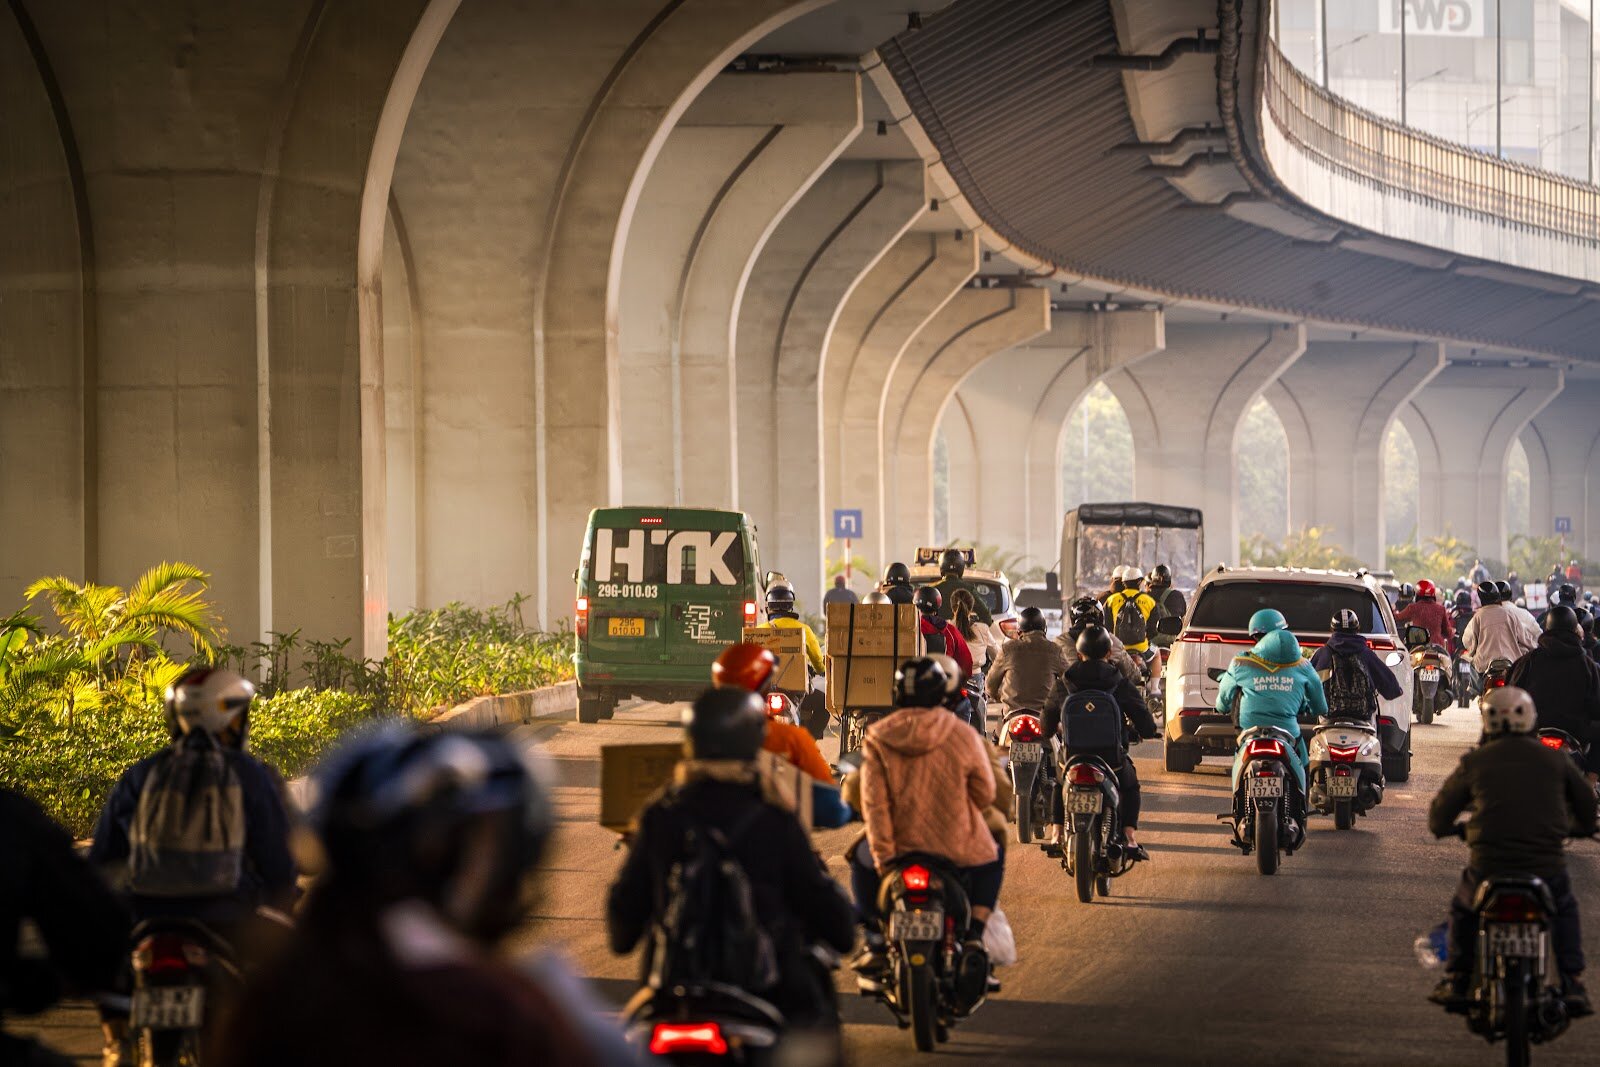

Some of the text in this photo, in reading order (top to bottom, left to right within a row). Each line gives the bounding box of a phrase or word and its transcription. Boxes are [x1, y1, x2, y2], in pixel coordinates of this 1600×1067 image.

[1391, 0, 1472, 32] FWD
[598, 585, 658, 599] 29G-010.03
[612, 627, 641, 635] 010.03
[1253, 676, 1294, 684] XANH SM
[1012, 753, 1038, 762] 745.31
[1252, 787, 1280, 797] 137.49
